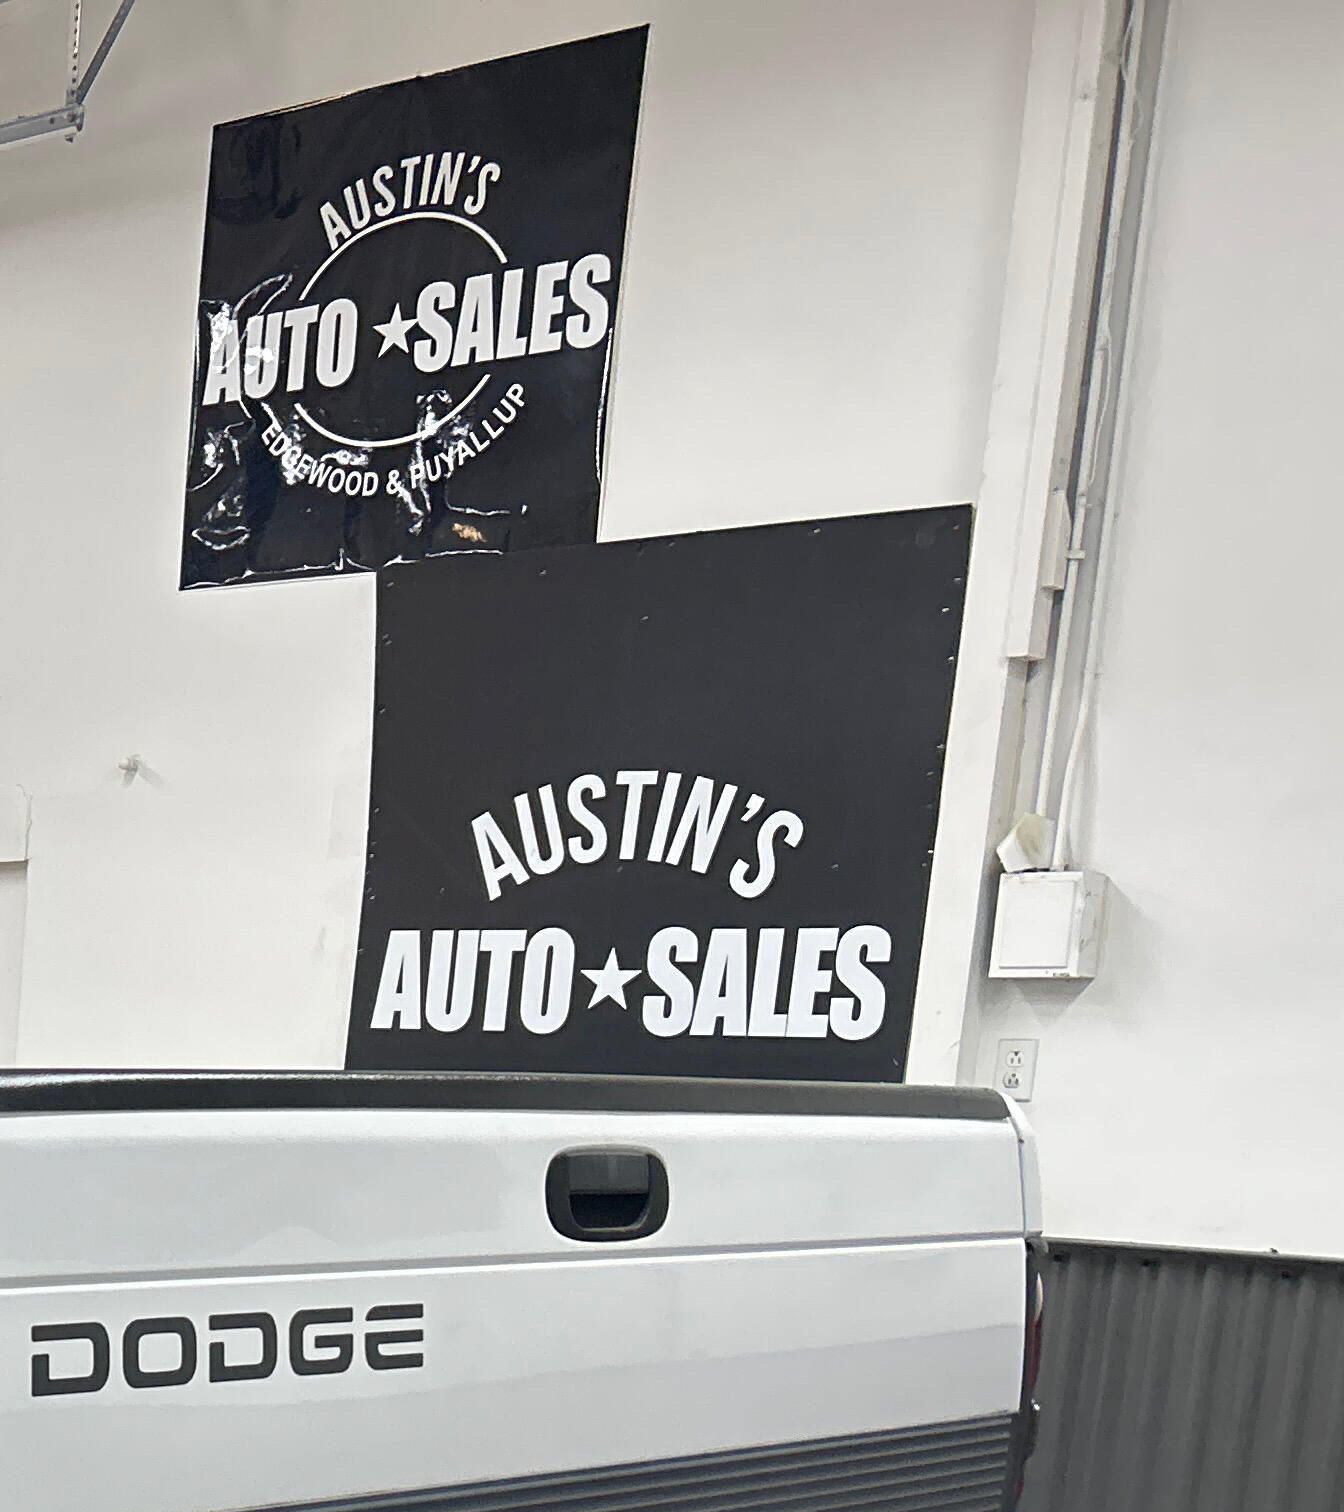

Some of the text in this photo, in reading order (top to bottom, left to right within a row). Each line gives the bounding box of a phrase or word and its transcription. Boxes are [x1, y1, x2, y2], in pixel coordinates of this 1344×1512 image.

[319, 150, 501, 252] AUSTIN'S
[202, 253, 612, 406] AUTO SALES
[410, 382, 529, 490] PUYALLUP
[470, 769, 804, 901] AUSTIN'S
[369, 925, 893, 1042] AUTO SALES
[30, 1303, 424, 1397] DODGE
